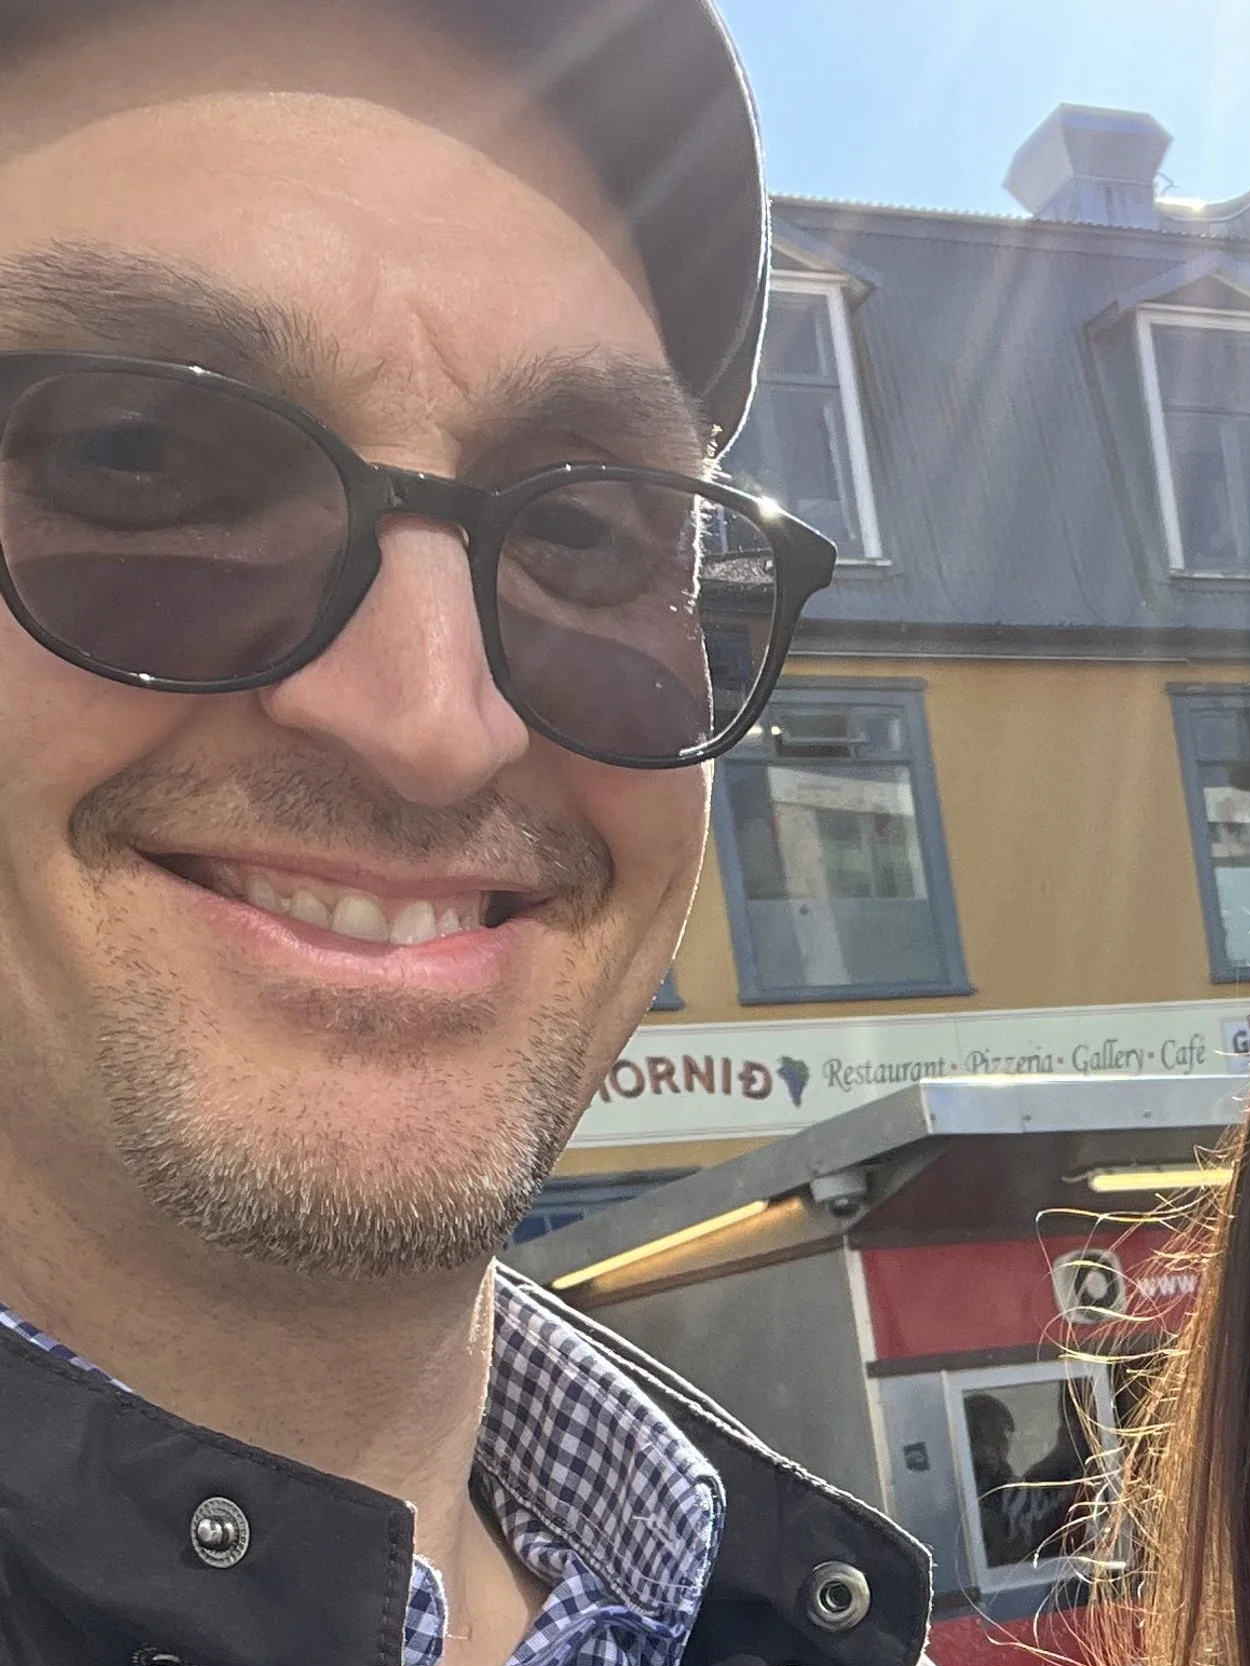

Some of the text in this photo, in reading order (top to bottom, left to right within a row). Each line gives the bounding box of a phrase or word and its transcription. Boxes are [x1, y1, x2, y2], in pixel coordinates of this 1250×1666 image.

[600, 1032, 1206, 1104] ORNIÐ Restaurant Pizzeria Gallery Café
